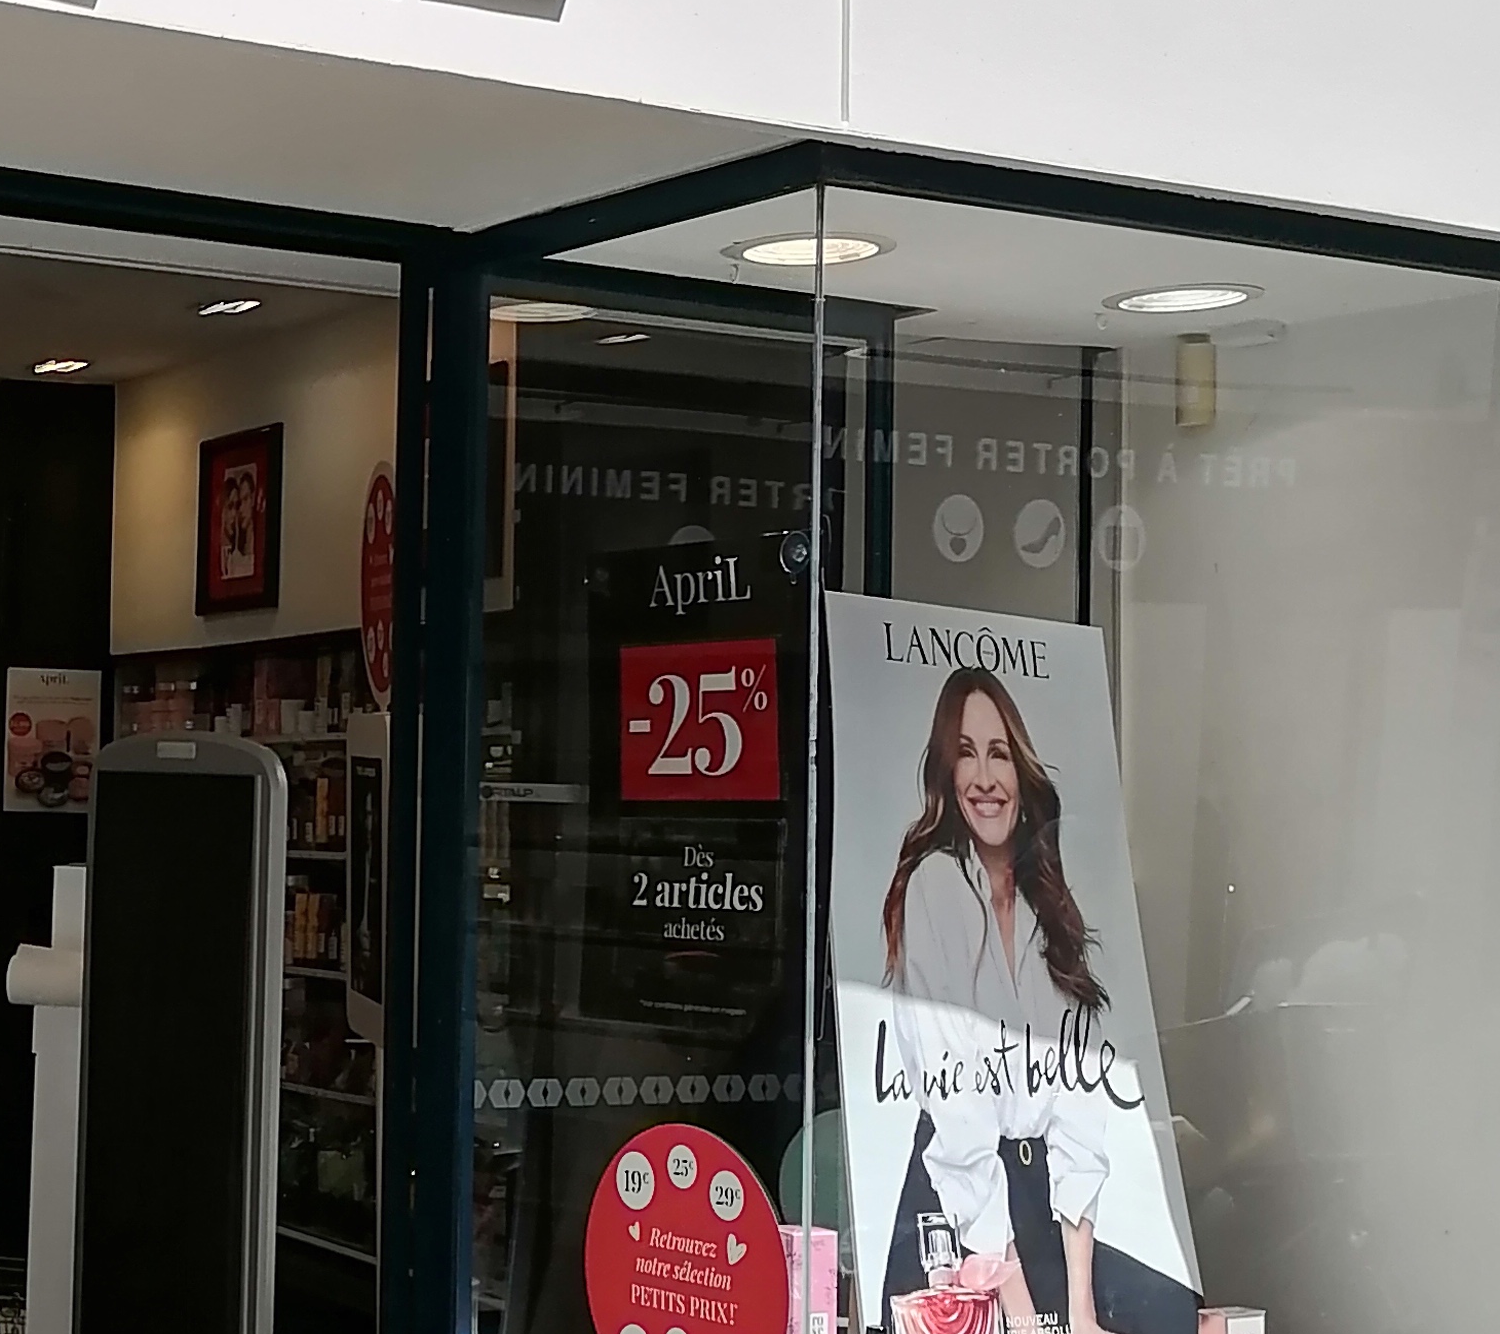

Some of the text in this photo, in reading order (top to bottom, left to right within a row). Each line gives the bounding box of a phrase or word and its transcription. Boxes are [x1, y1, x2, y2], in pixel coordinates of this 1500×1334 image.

[649, 555, 751, 616] ApriL
[883, 621, 1050, 679] LANCÔME
[628, 664, 768, 776] -25%
[683, 843, 714, 868] Dès
[632, 871, 764, 912] 2 articles
[663, 916, 725, 942] achetés
[875, 1001, 1146, 1110] La vie est belle
[649, 1227, 718, 1259] Retrouvez
[635, 1257, 732, 1291] notre sélection
[630, 1283, 686, 1315] PETITS
[1005, 1311, 1059, 1328] NOUVEAU
